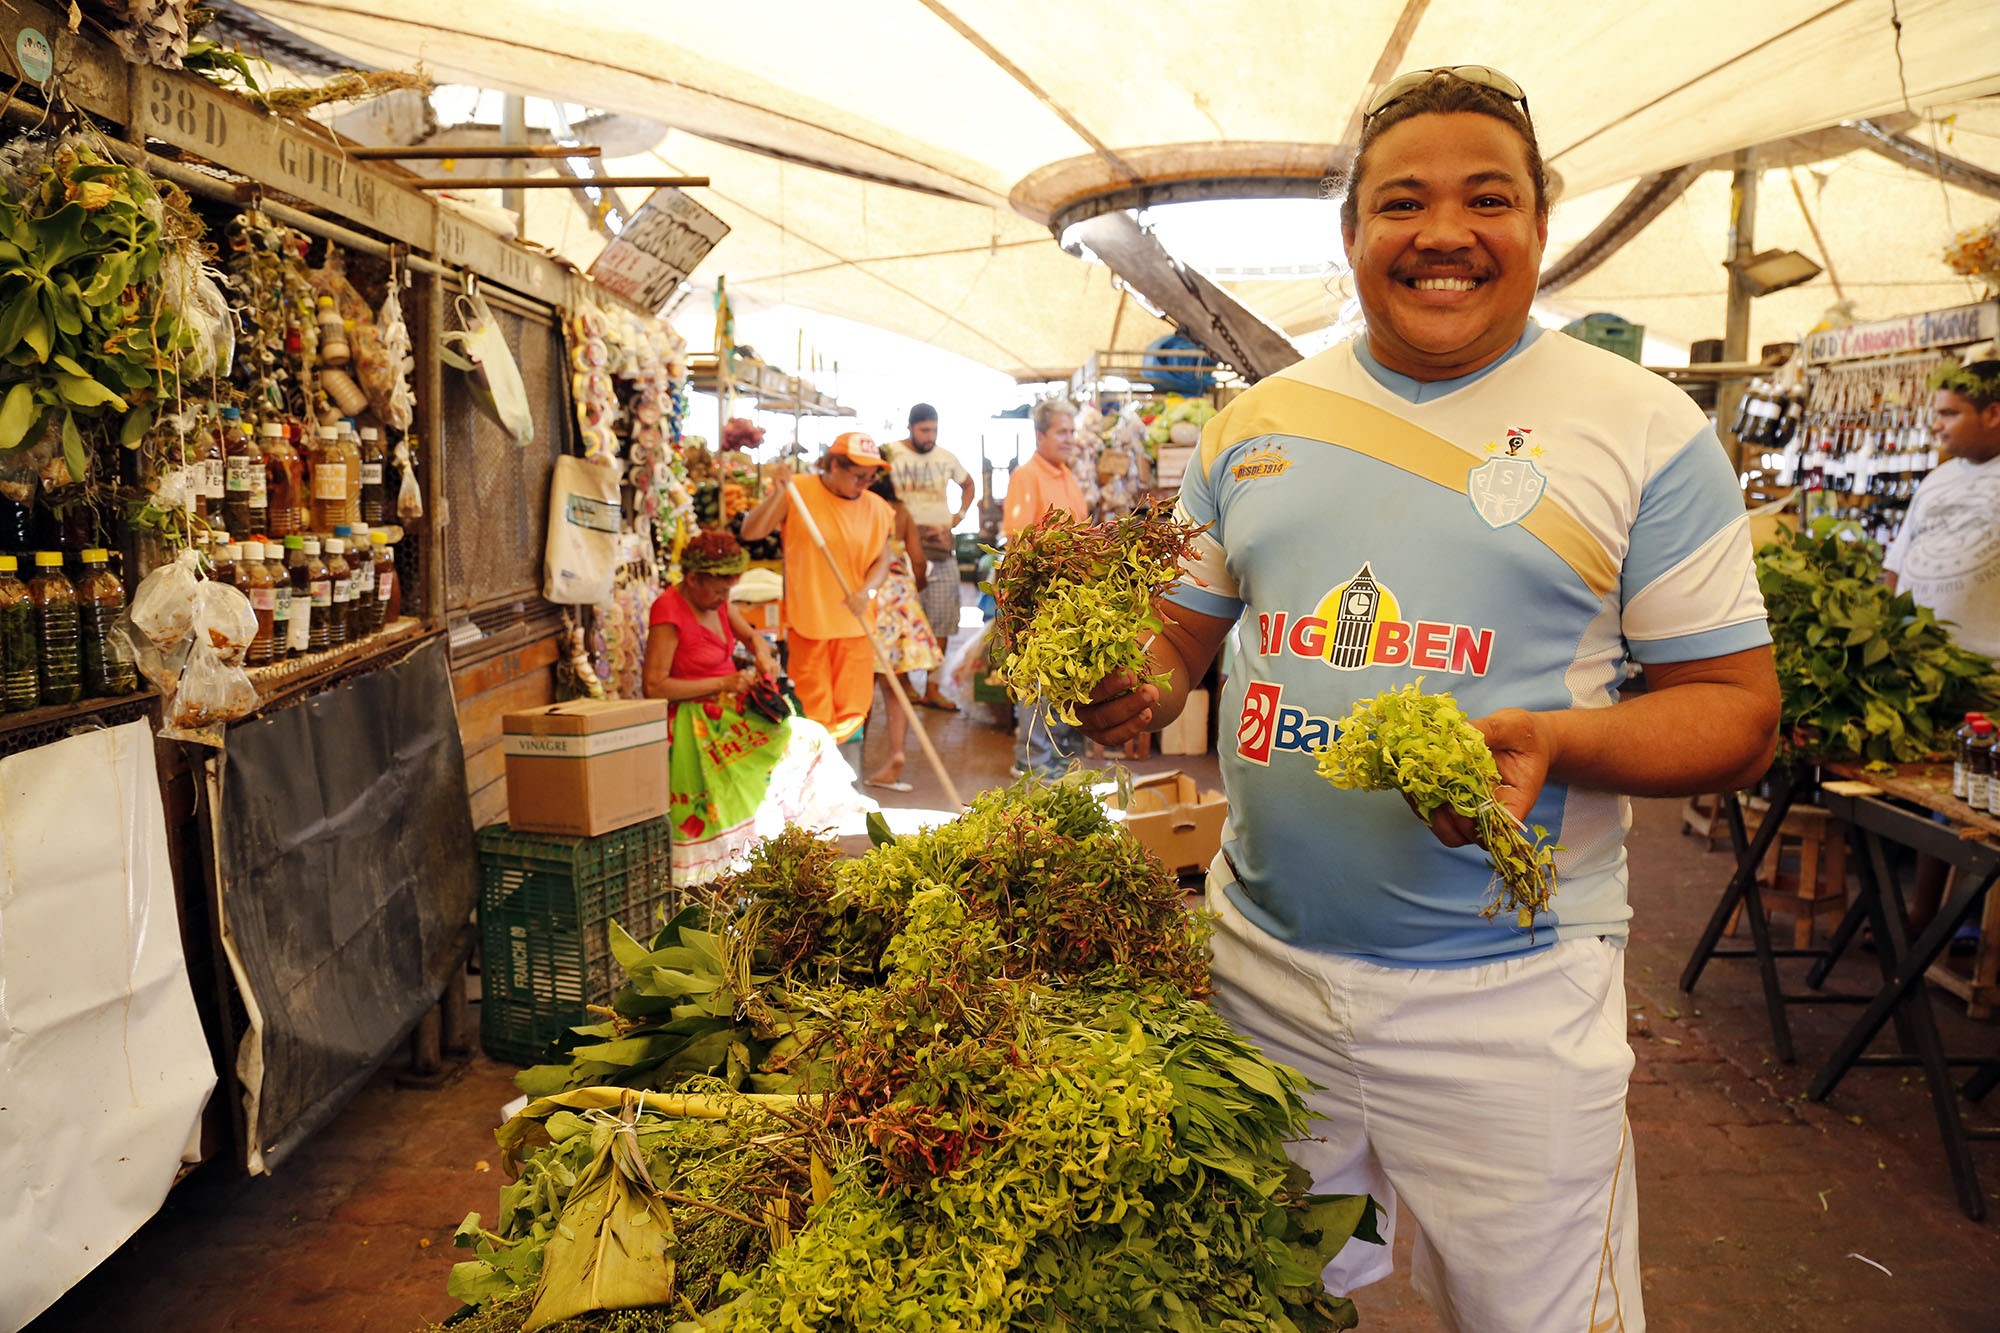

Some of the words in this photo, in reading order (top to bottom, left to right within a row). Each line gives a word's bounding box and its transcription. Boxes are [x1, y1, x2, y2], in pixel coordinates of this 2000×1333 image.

[1238, 464, 1262, 479] DESDE
[1263, 463, 1284, 474] 1914
[1502, 470, 1514, 485] S
[1526, 478, 1538, 492] C
[1259, 611, 1329, 657] BIG
[1373, 622, 1492, 676] BEN
[518, 739, 568, 752] VINAGRE
[513, 941, 528, 989] FRANCHI
